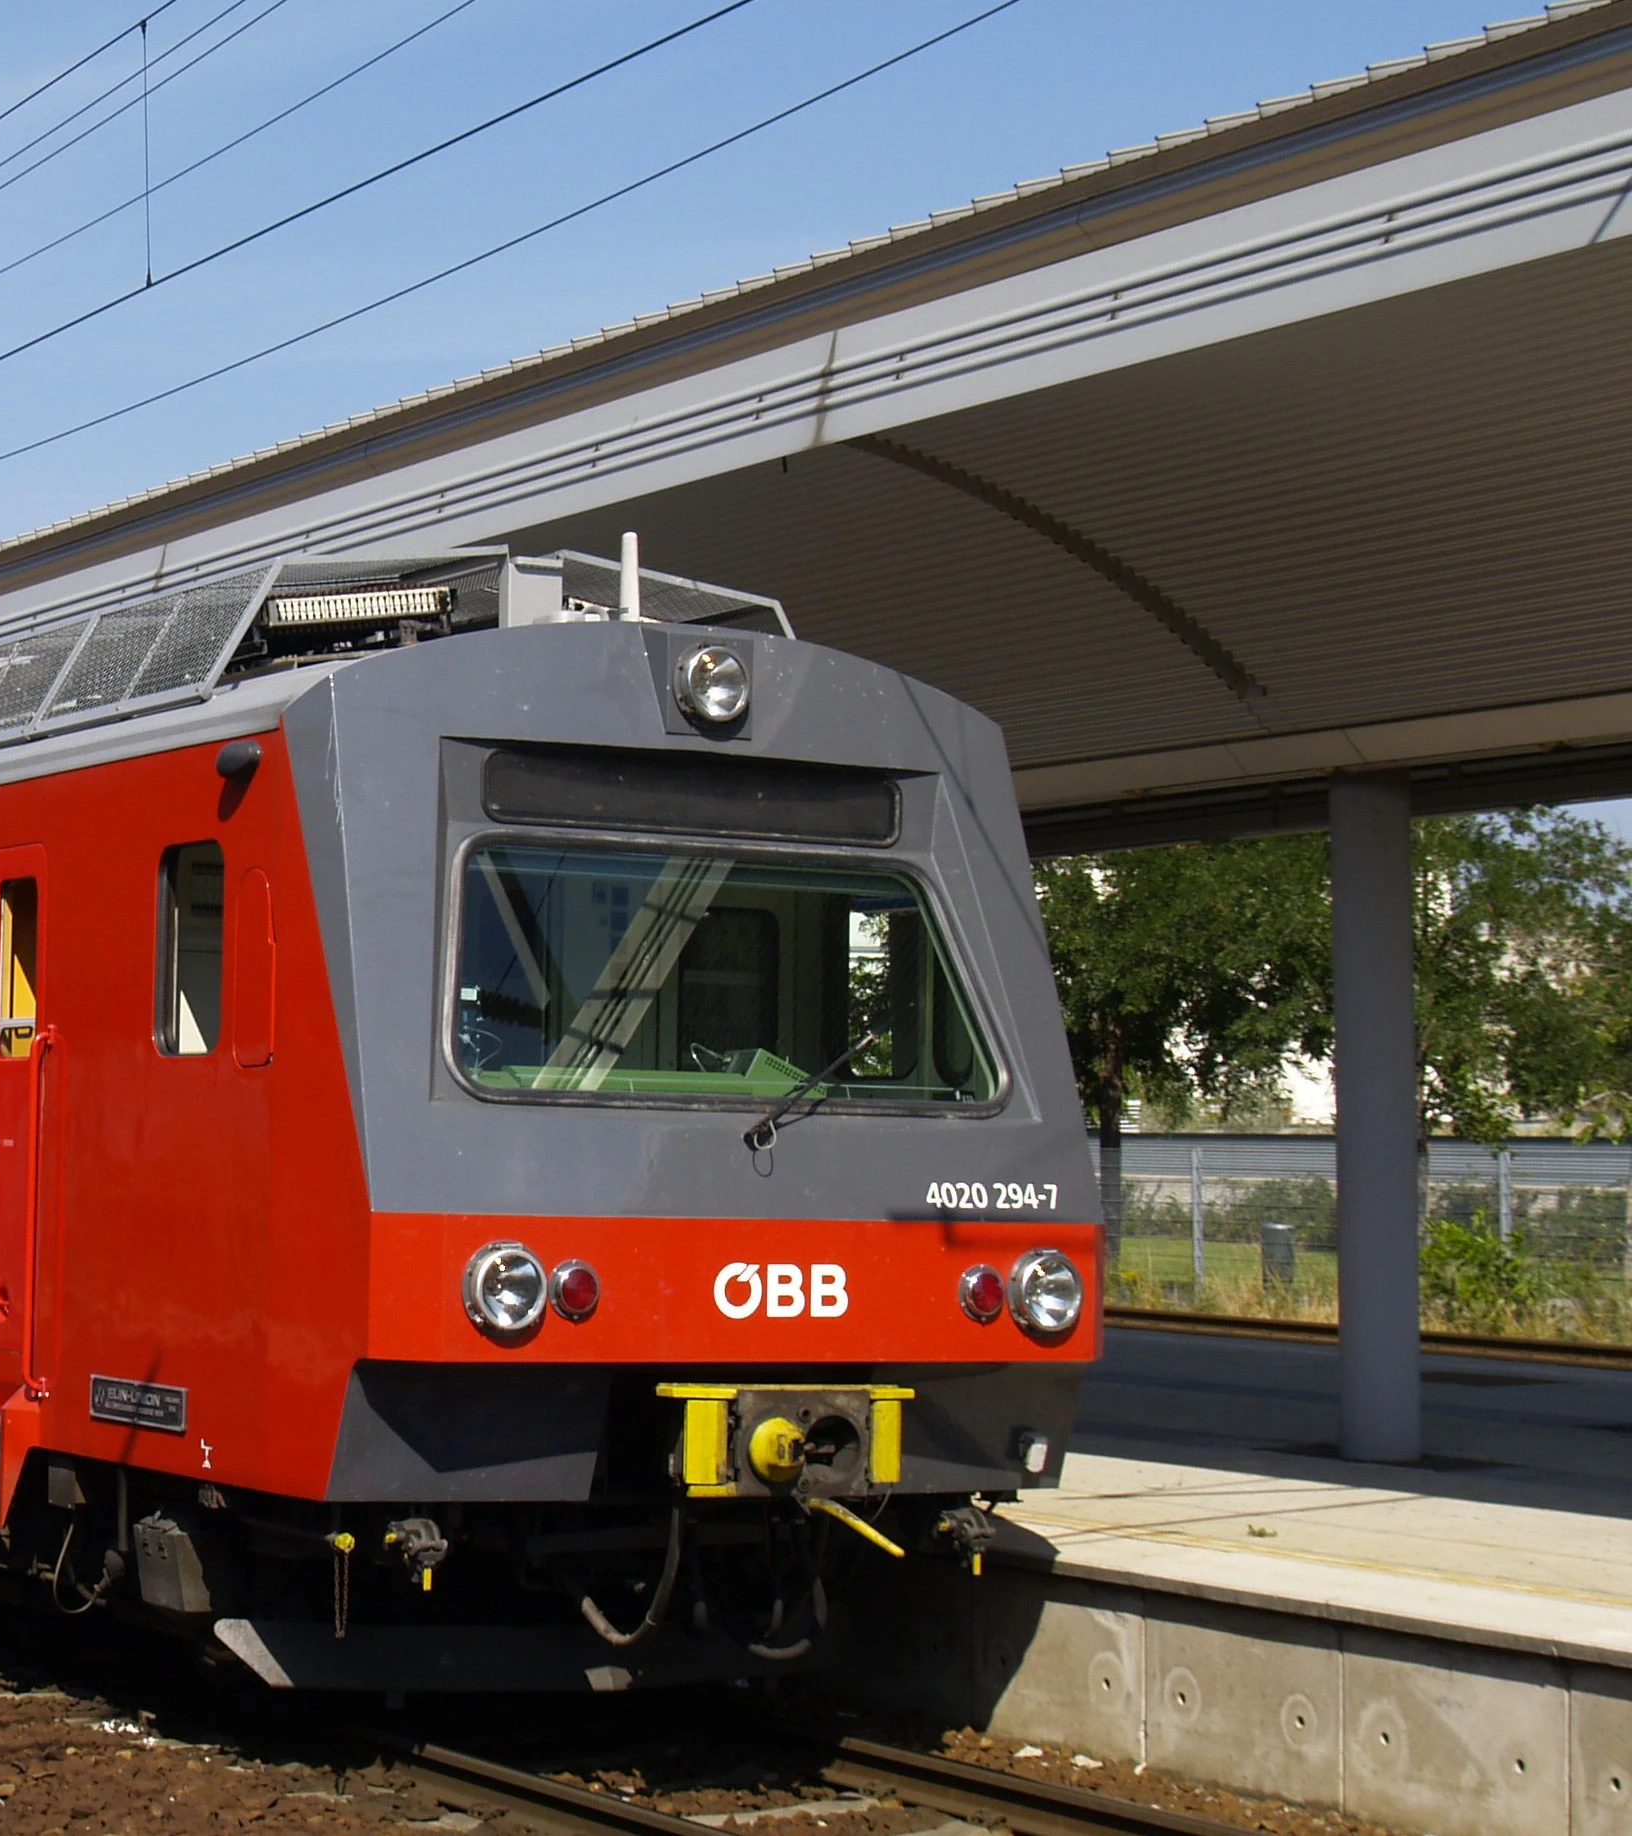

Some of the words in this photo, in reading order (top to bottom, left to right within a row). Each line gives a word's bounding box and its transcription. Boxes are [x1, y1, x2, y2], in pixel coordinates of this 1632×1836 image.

[926, 1182, 989, 1209] 4020
[992, 1182, 1058, 1210] 294-7
[713, 1262, 849, 1320] ÖBB
